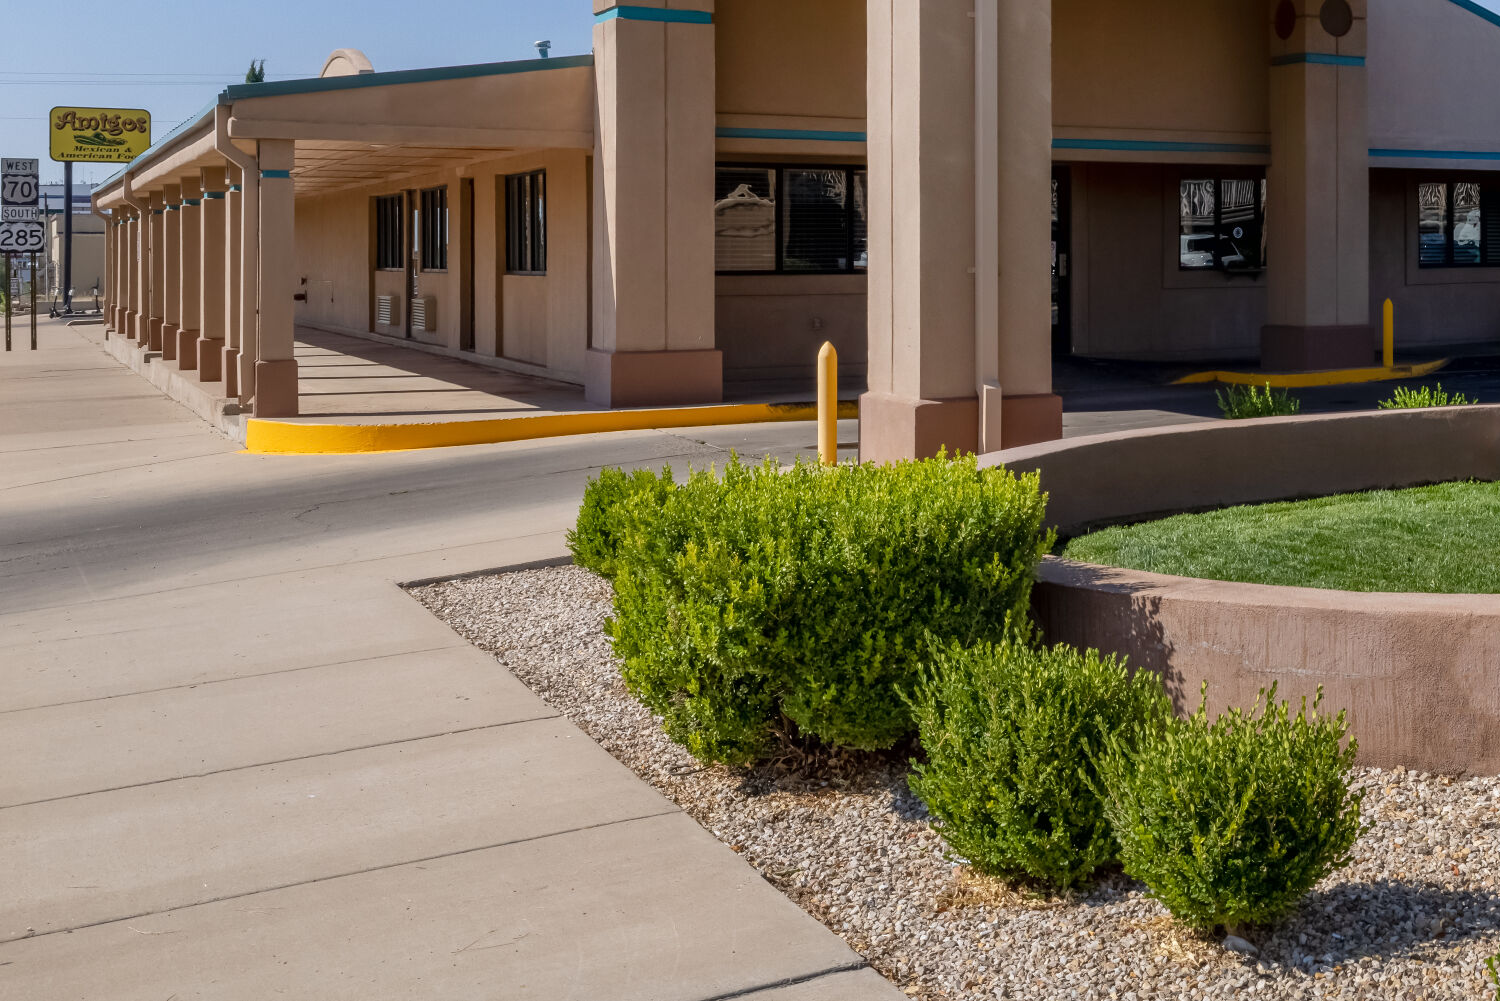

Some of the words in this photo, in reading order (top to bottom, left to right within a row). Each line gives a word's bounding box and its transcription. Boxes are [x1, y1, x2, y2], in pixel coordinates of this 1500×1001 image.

[54, 110, 147, 136] Amigos
[73, 145, 120, 153] Mexican
[6, 161, 33, 171] WEST
[8, 181, 32, 198] 70
[4, 208, 37, 218] SOUTH
[0, 229, 42, 246] 285
